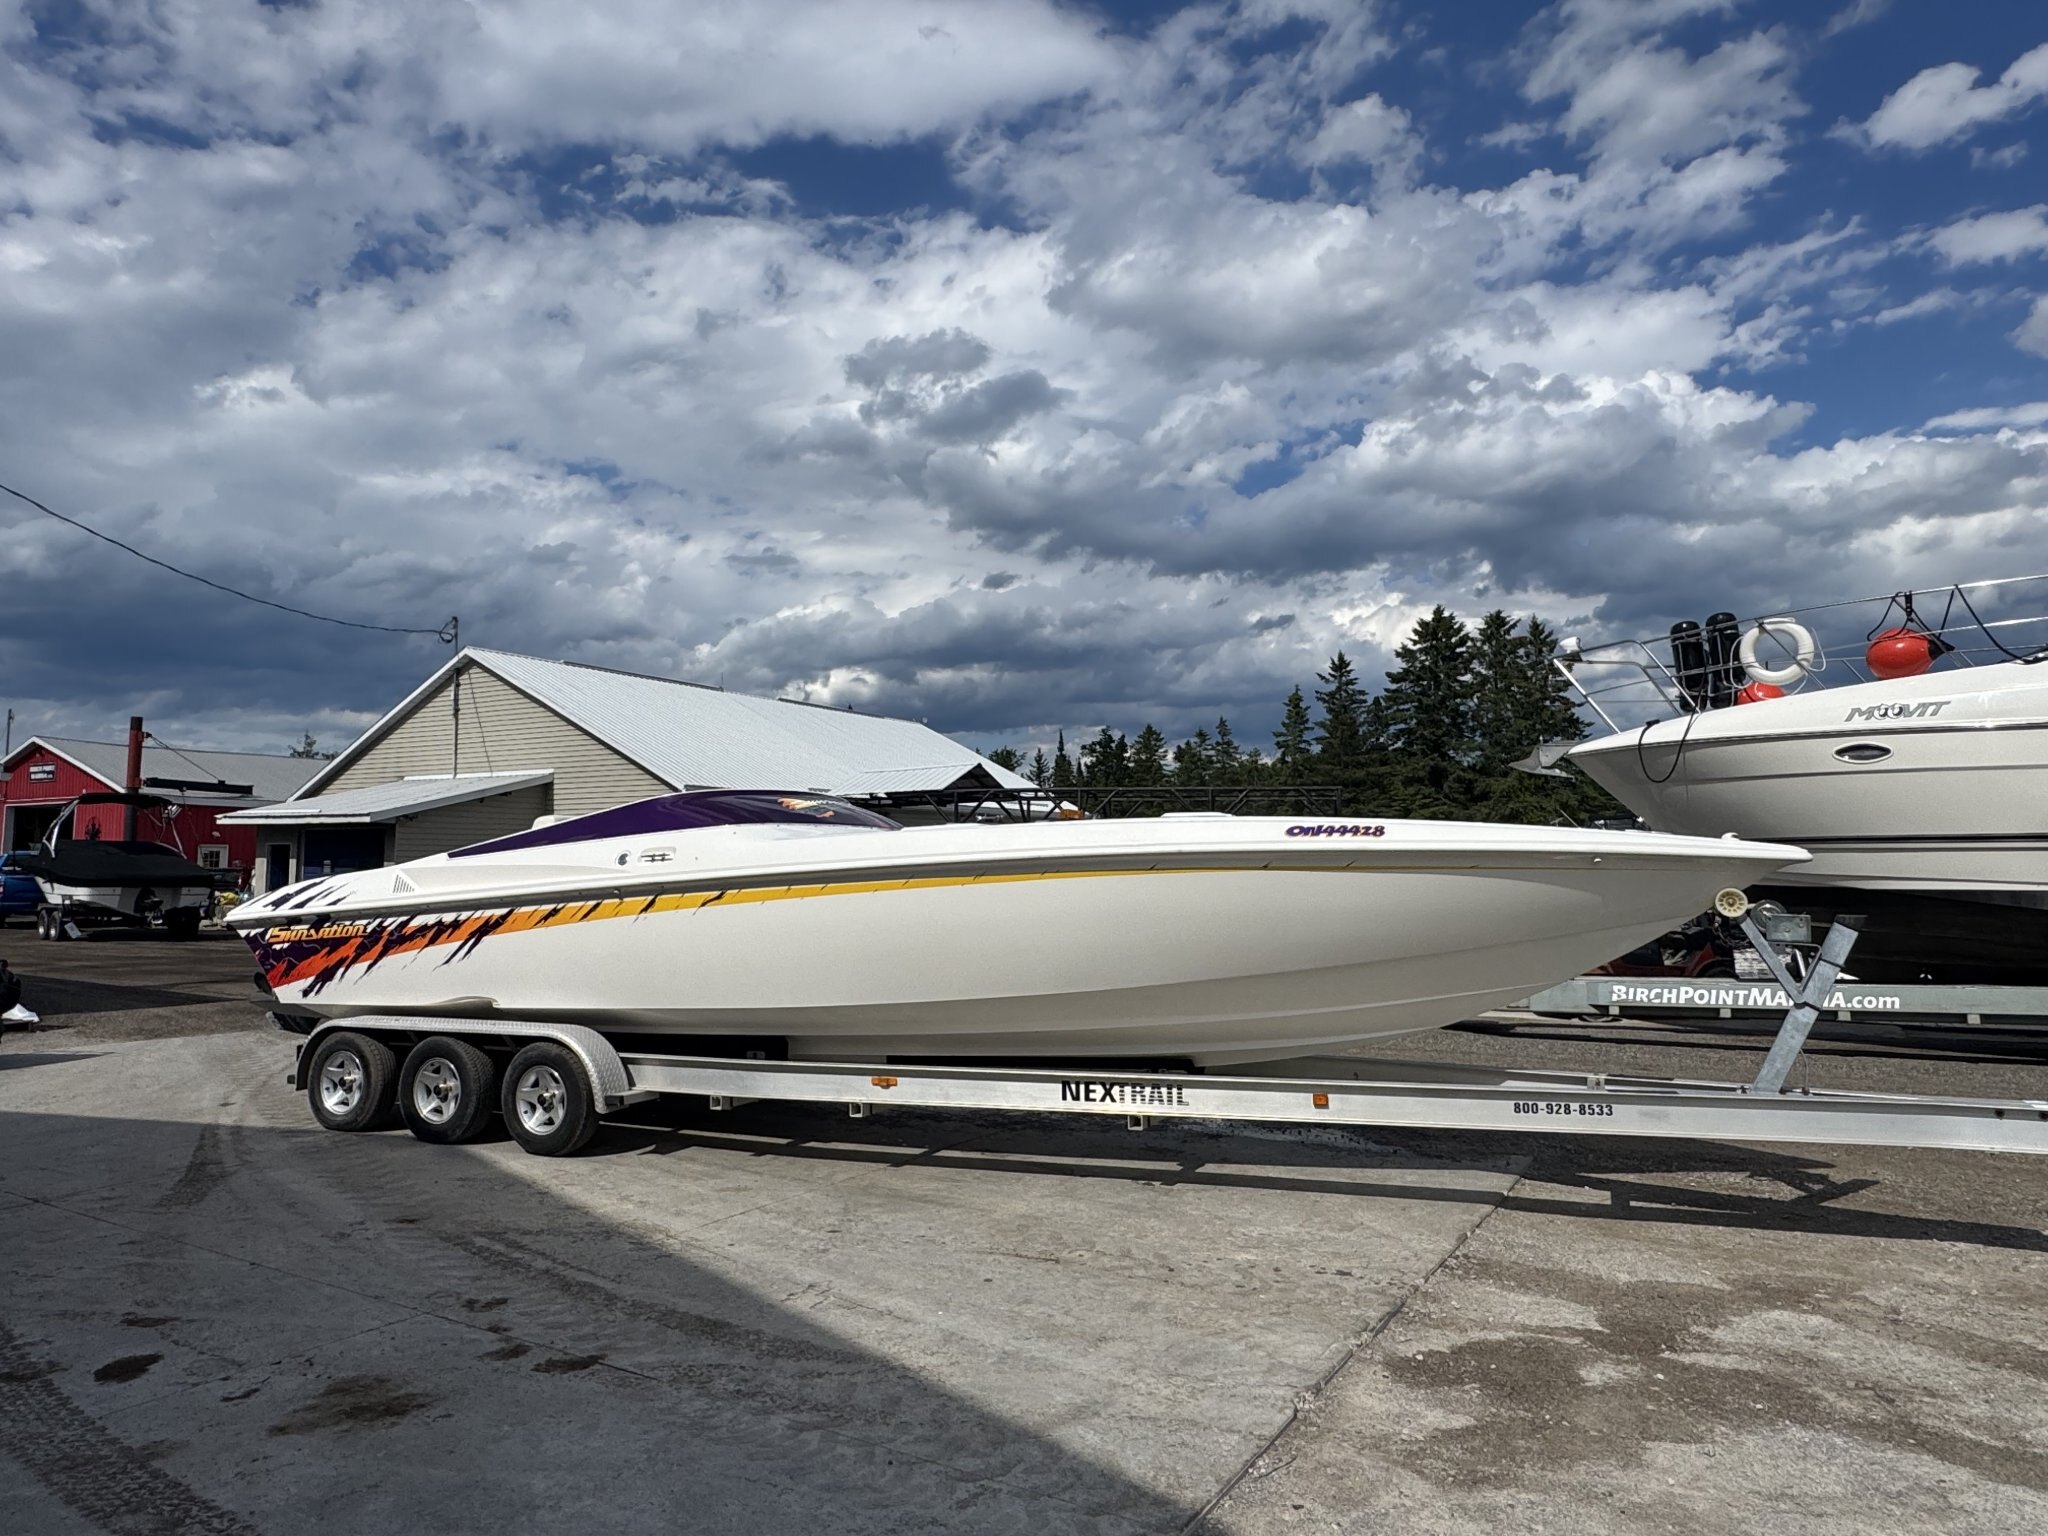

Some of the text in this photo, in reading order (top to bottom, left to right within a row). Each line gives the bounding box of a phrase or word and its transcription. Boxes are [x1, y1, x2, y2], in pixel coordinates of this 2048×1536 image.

[267, 924, 369, 943] Sunsation
[1061, 1080, 1190, 1106] NEXTRAIL
[1513, 1102, 1614, 1116] 800-928-8533
